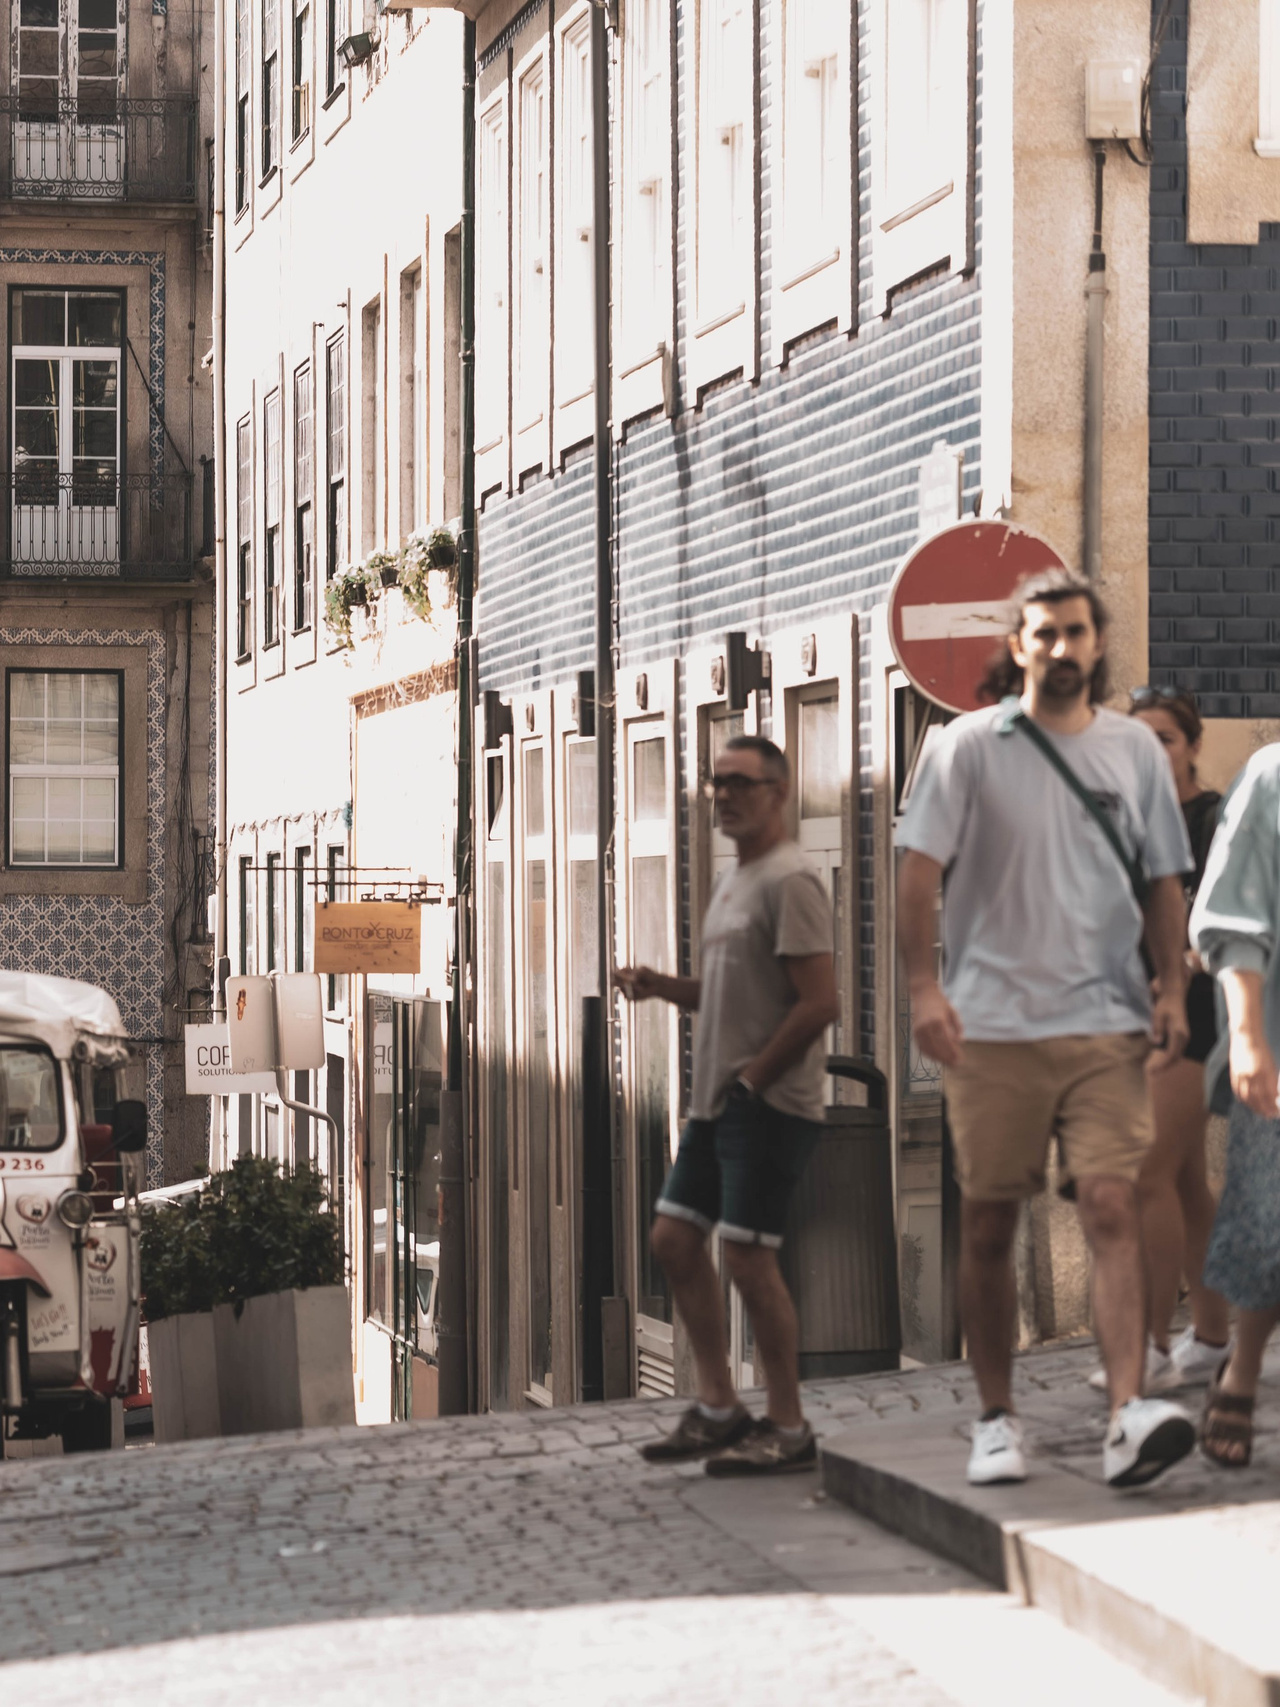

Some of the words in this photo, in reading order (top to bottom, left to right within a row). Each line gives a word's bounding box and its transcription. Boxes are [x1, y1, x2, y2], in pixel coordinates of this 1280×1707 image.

[322, 926, 373, 940] PONTO
[376, 926, 413, 940] CRUZ
[11, 1158, 45, 1171] 236
